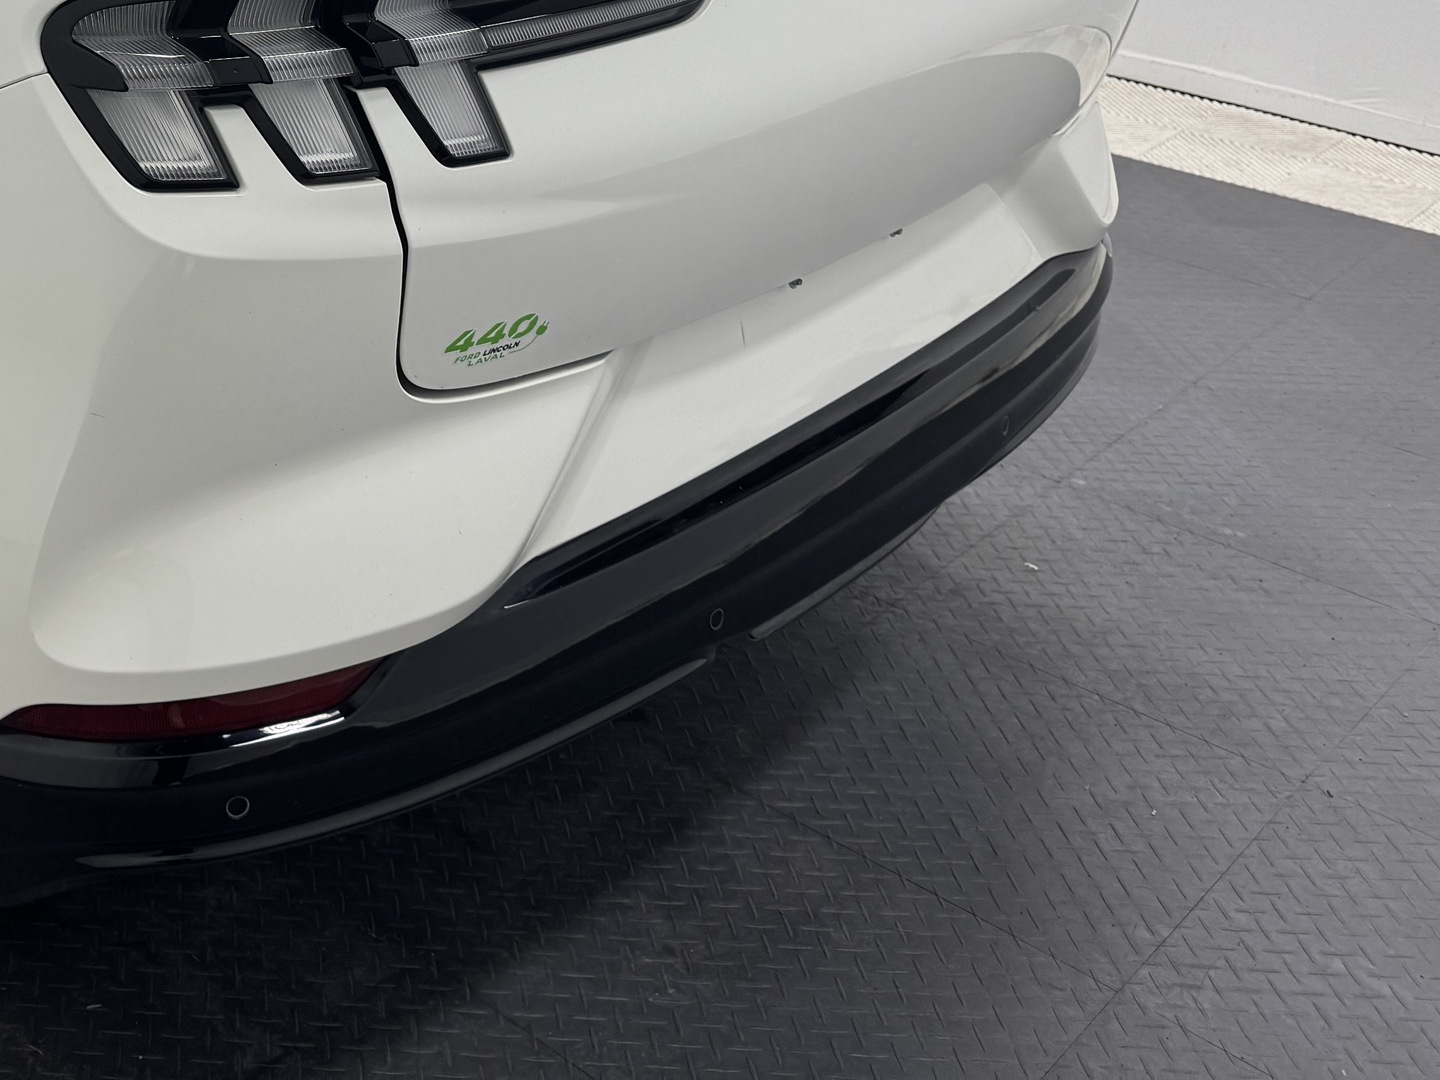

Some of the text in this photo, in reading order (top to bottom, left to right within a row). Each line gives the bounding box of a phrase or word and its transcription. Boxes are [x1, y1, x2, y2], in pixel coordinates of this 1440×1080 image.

[444, 313, 538, 353] 440
[454, 341, 521, 363] FORD LINCOLN
[468, 352, 505, 366] LAVAL
